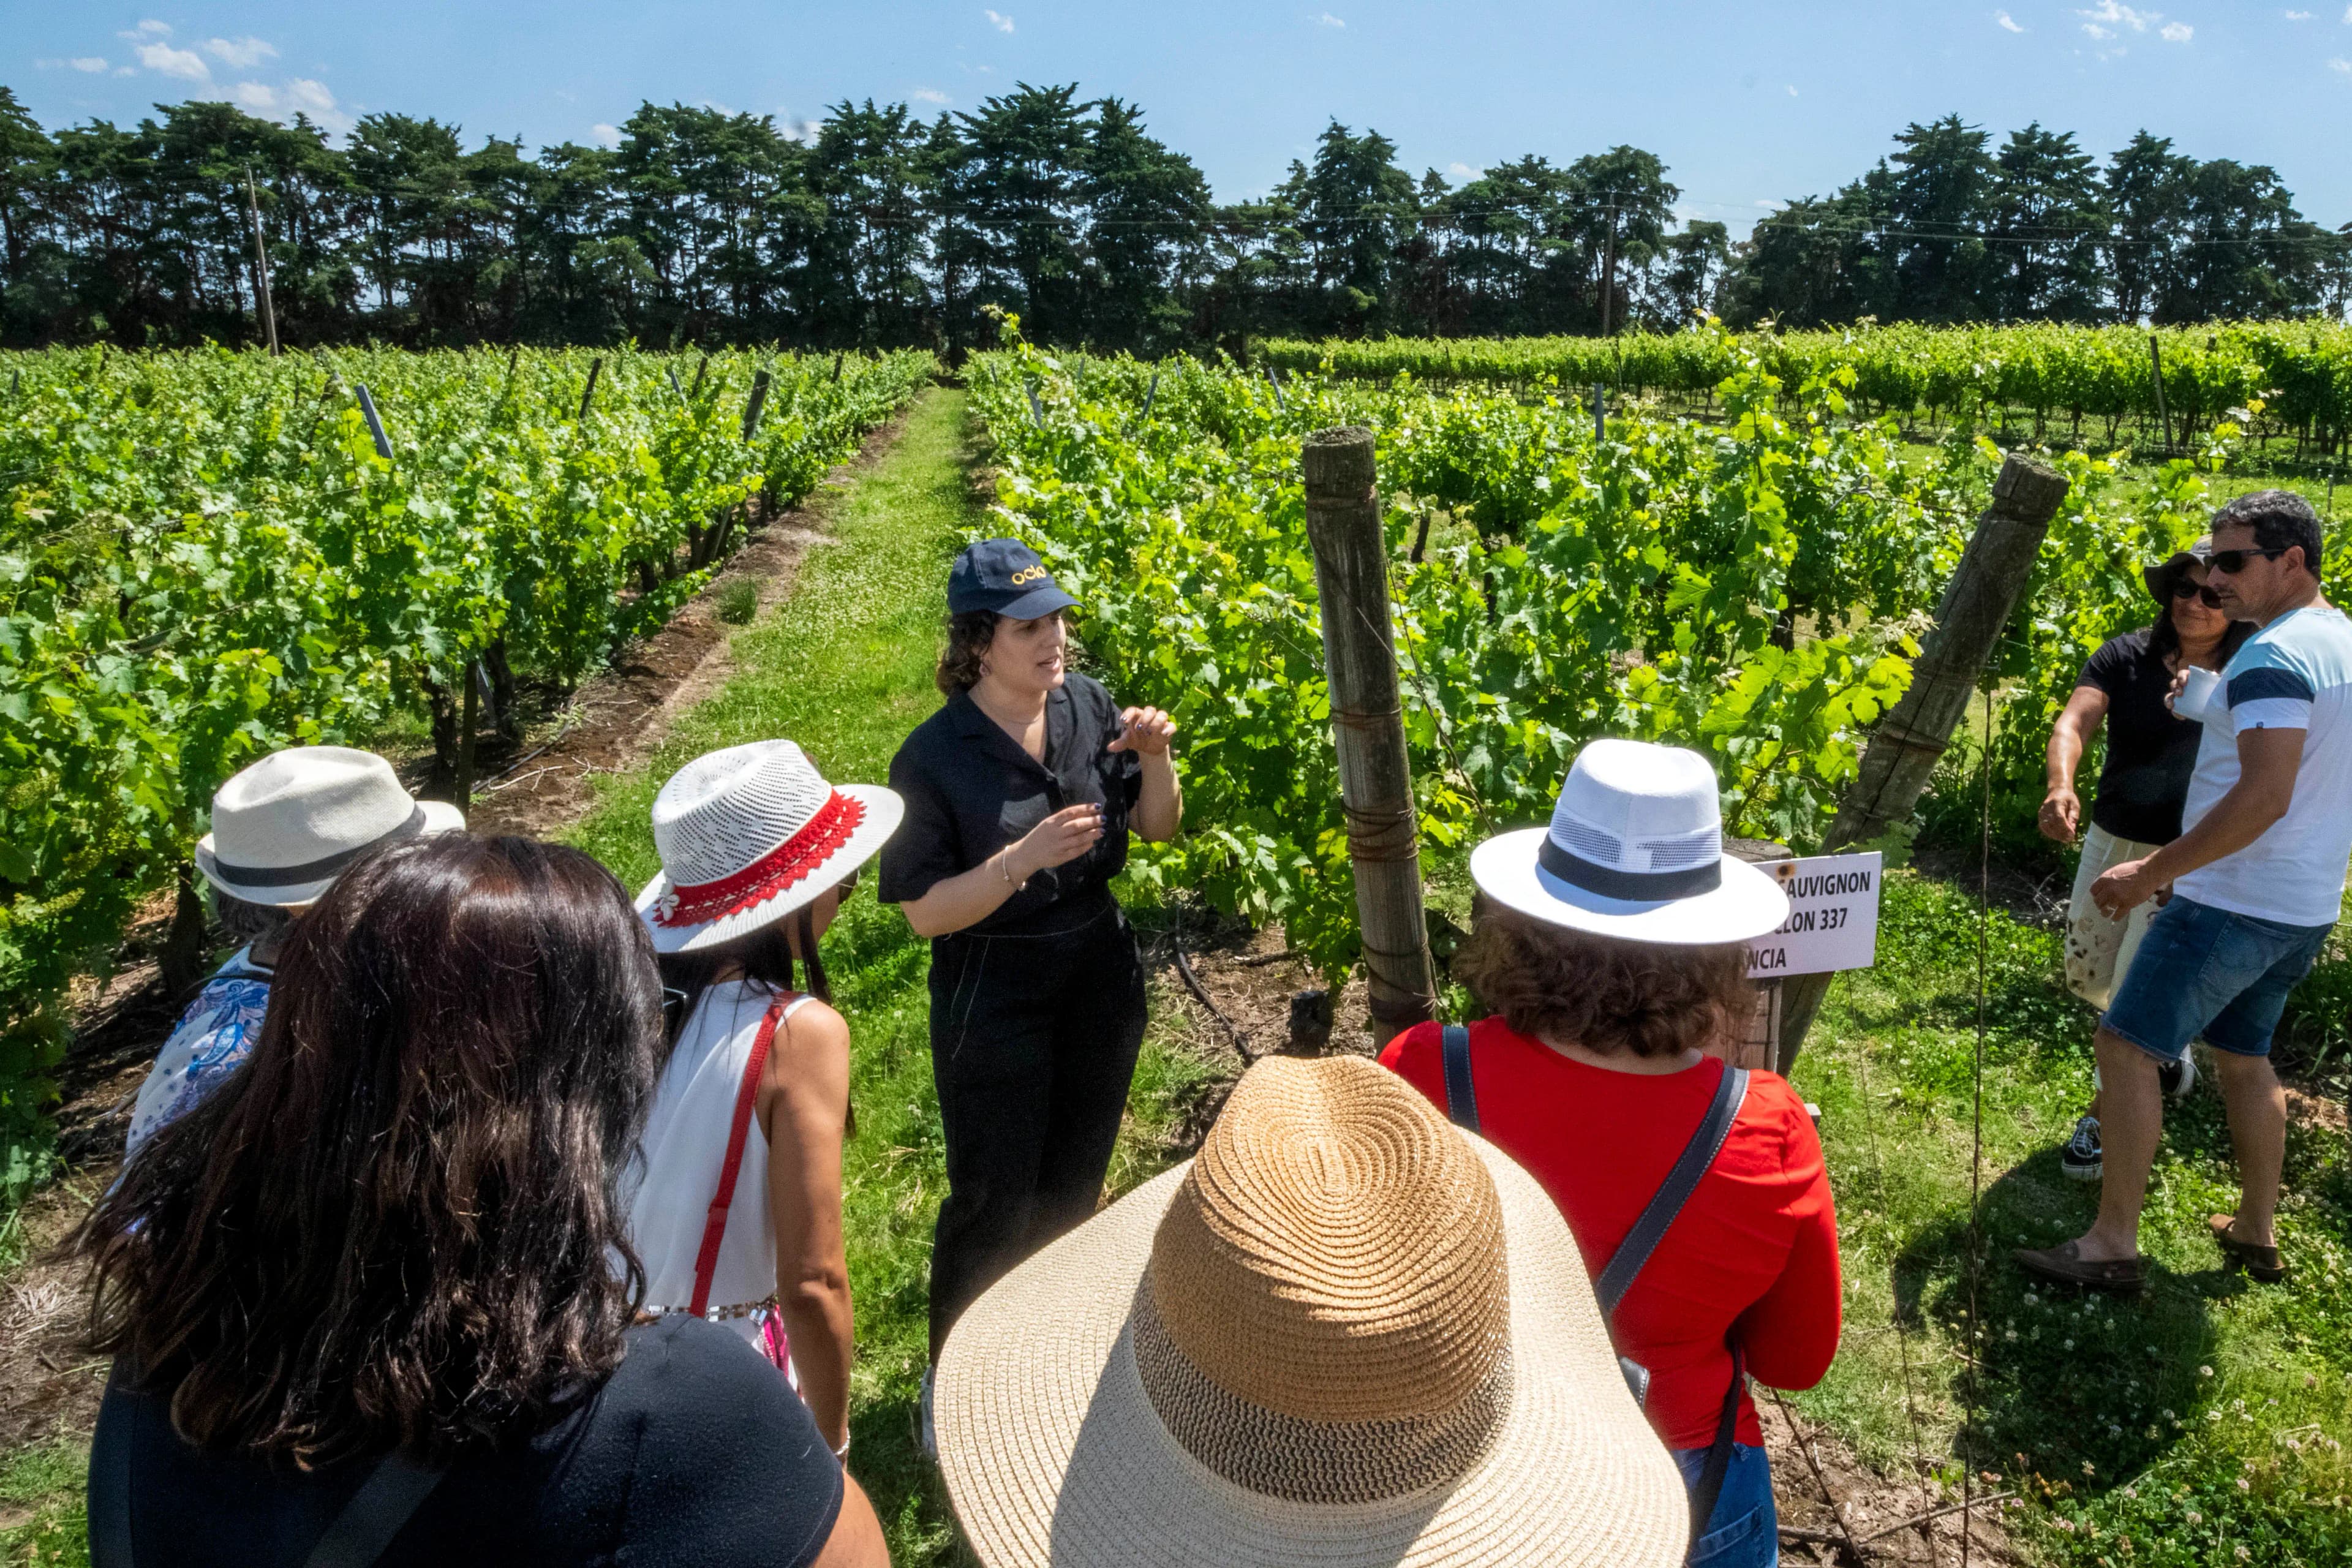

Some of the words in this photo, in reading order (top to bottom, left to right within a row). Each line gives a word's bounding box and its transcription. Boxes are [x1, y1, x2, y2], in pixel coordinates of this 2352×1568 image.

[1779, 871, 1871, 899] AUVIGNON
[1774, 910, 1815, 934] LON
[1820, 907, 1848, 930] 337
